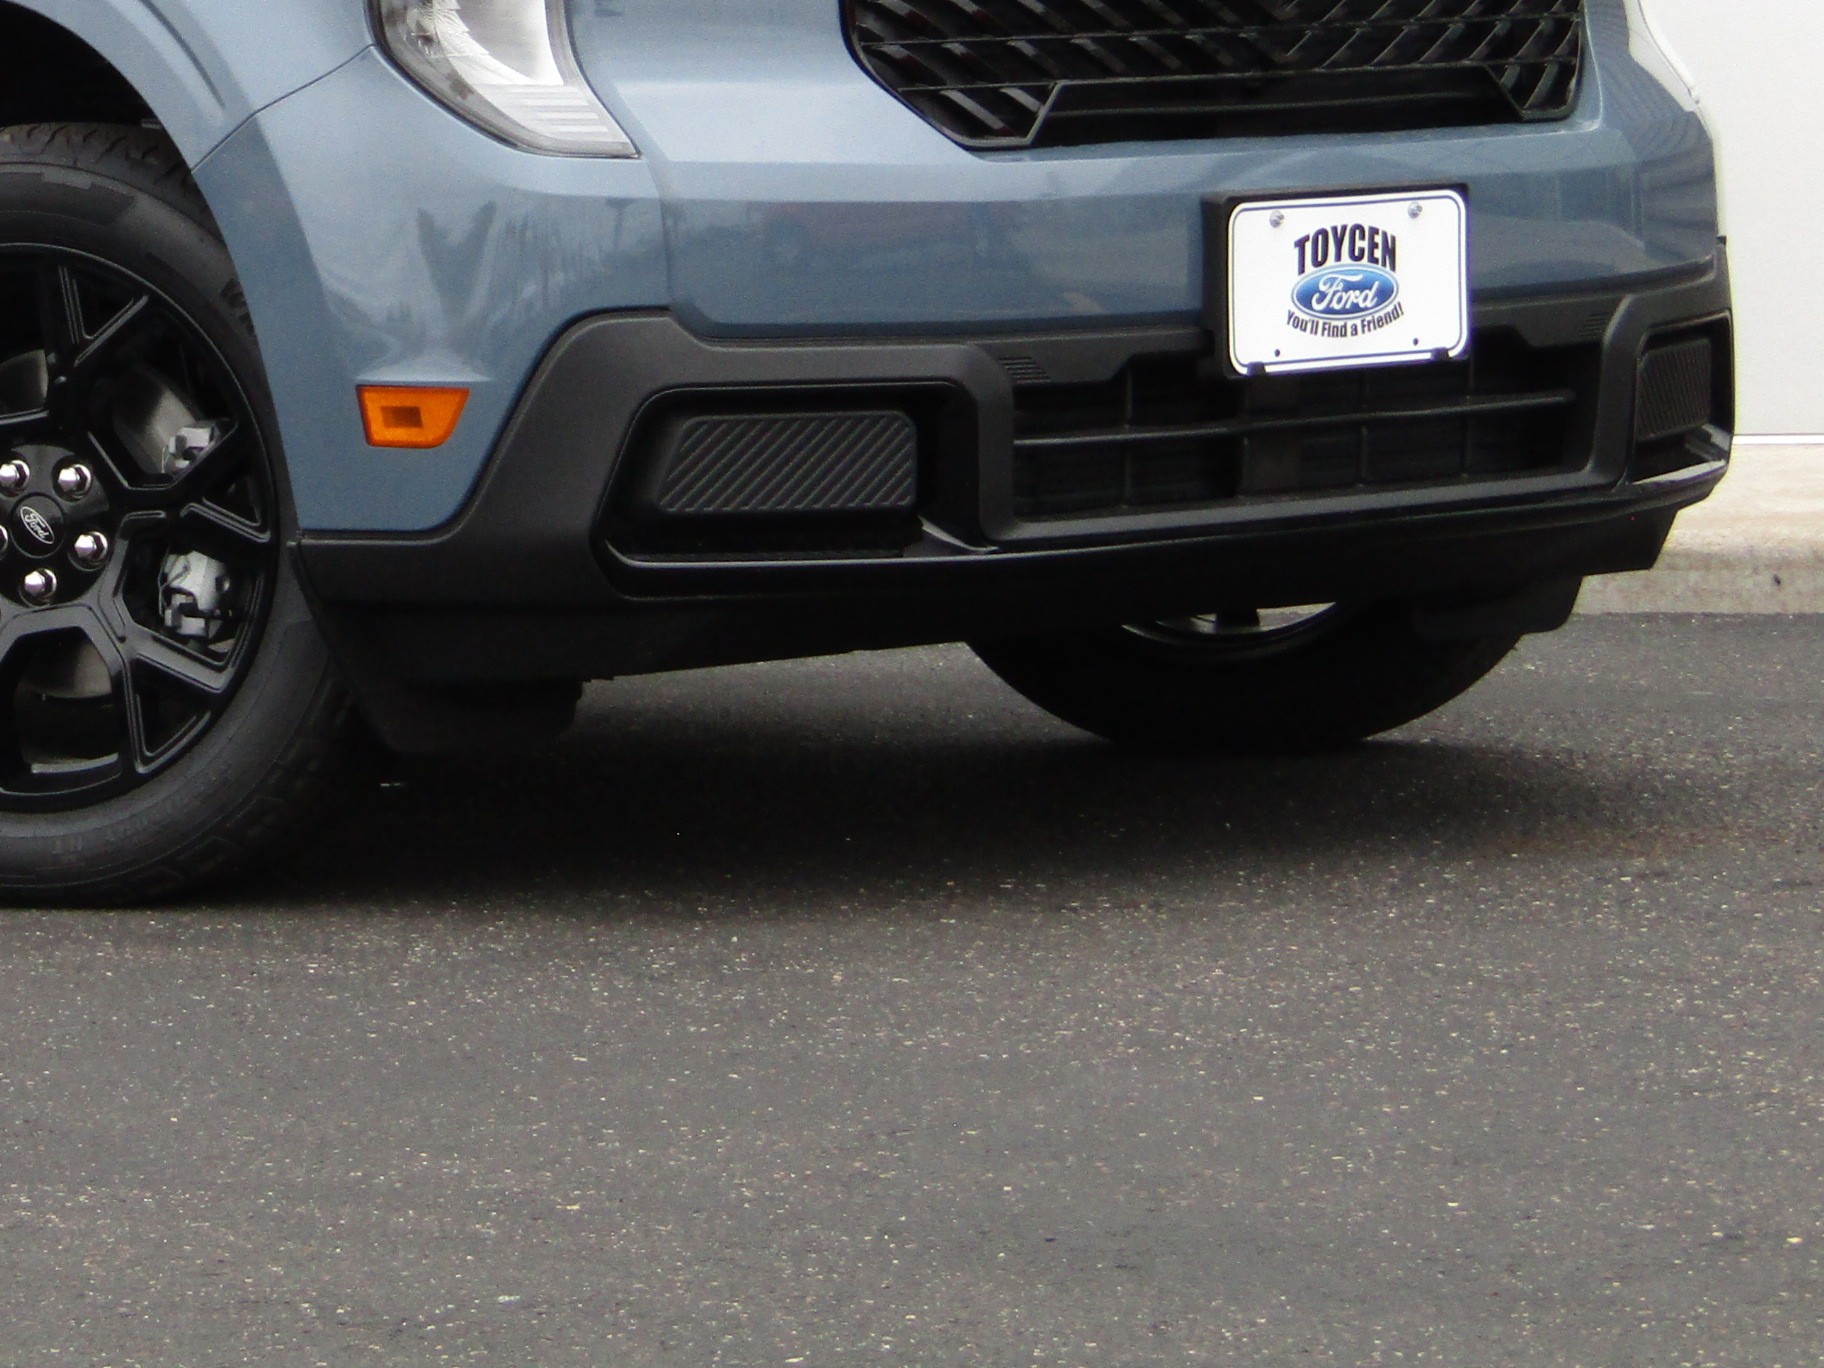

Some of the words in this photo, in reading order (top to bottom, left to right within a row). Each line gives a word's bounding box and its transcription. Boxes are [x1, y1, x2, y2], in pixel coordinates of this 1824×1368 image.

[1294, 223, 1396, 275] TOYCEN
[1311, 273, 1380, 311] Ford
[1286, 309, 1319, 337] You'll
[1321, 321, 1348, 338] Find
[1350, 324, 1358, 337] a
[1361, 301, 1405, 334] Friend!
[24, 512, 50, 539] Ford
